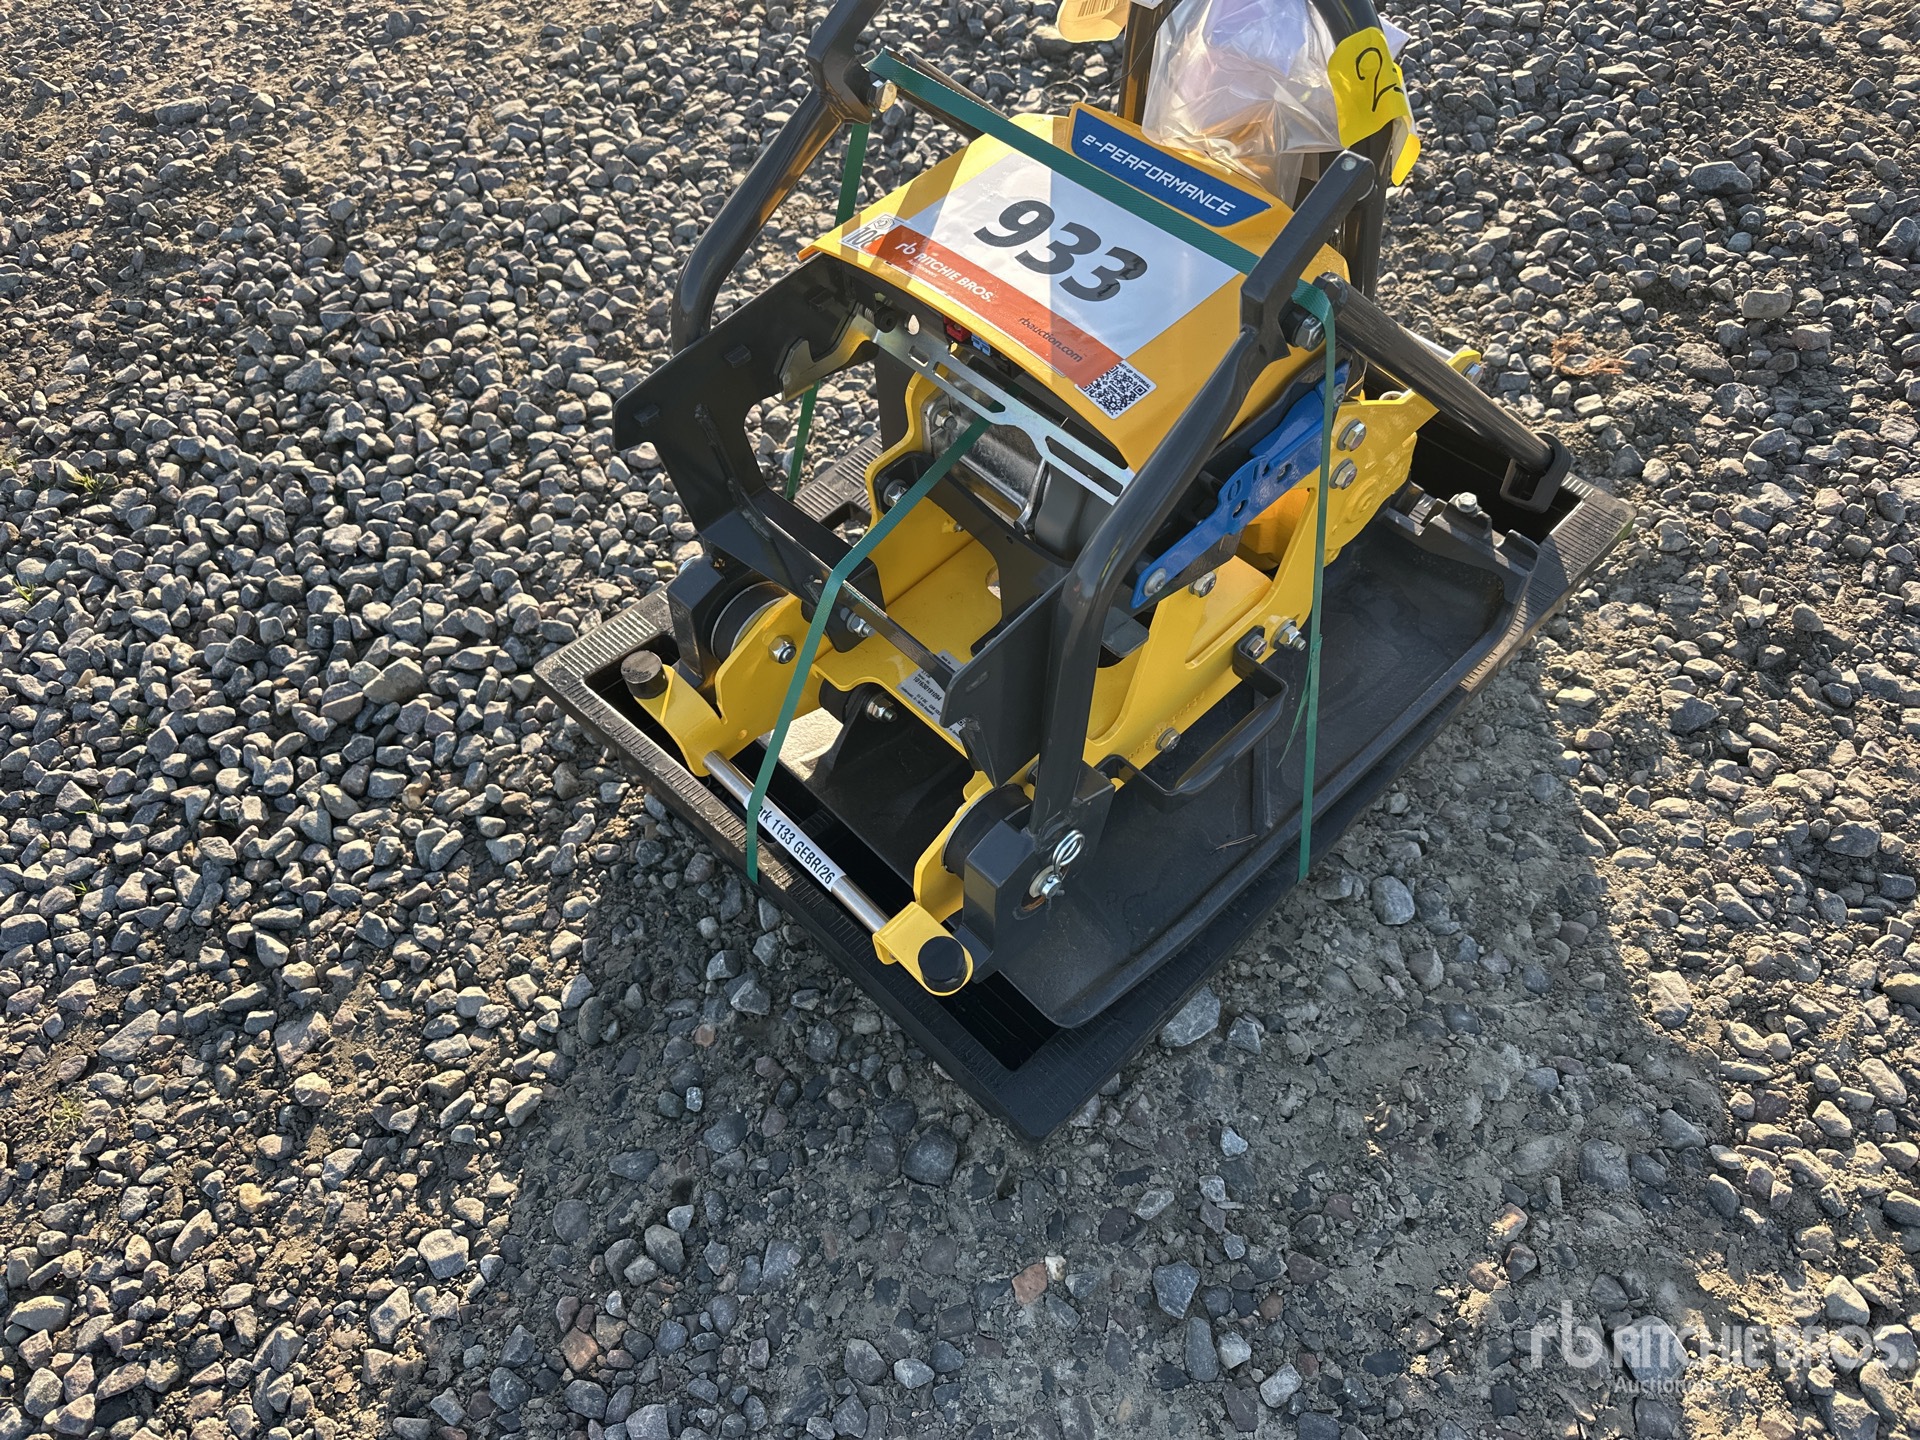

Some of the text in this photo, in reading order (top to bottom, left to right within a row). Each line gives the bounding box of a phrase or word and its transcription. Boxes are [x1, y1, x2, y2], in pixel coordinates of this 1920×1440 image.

[1081, 134, 1237, 216] e-PERFORMANCE
[894, 242, 916, 255] rb
[915, 252, 961, 281] RITCHIE
[973, 199, 1148, 302] 933
[1019, 316, 1083, 363] rbauction.com
[771, 819, 796, 845] 1133
[793, 841, 836, 885] GEBR/26
